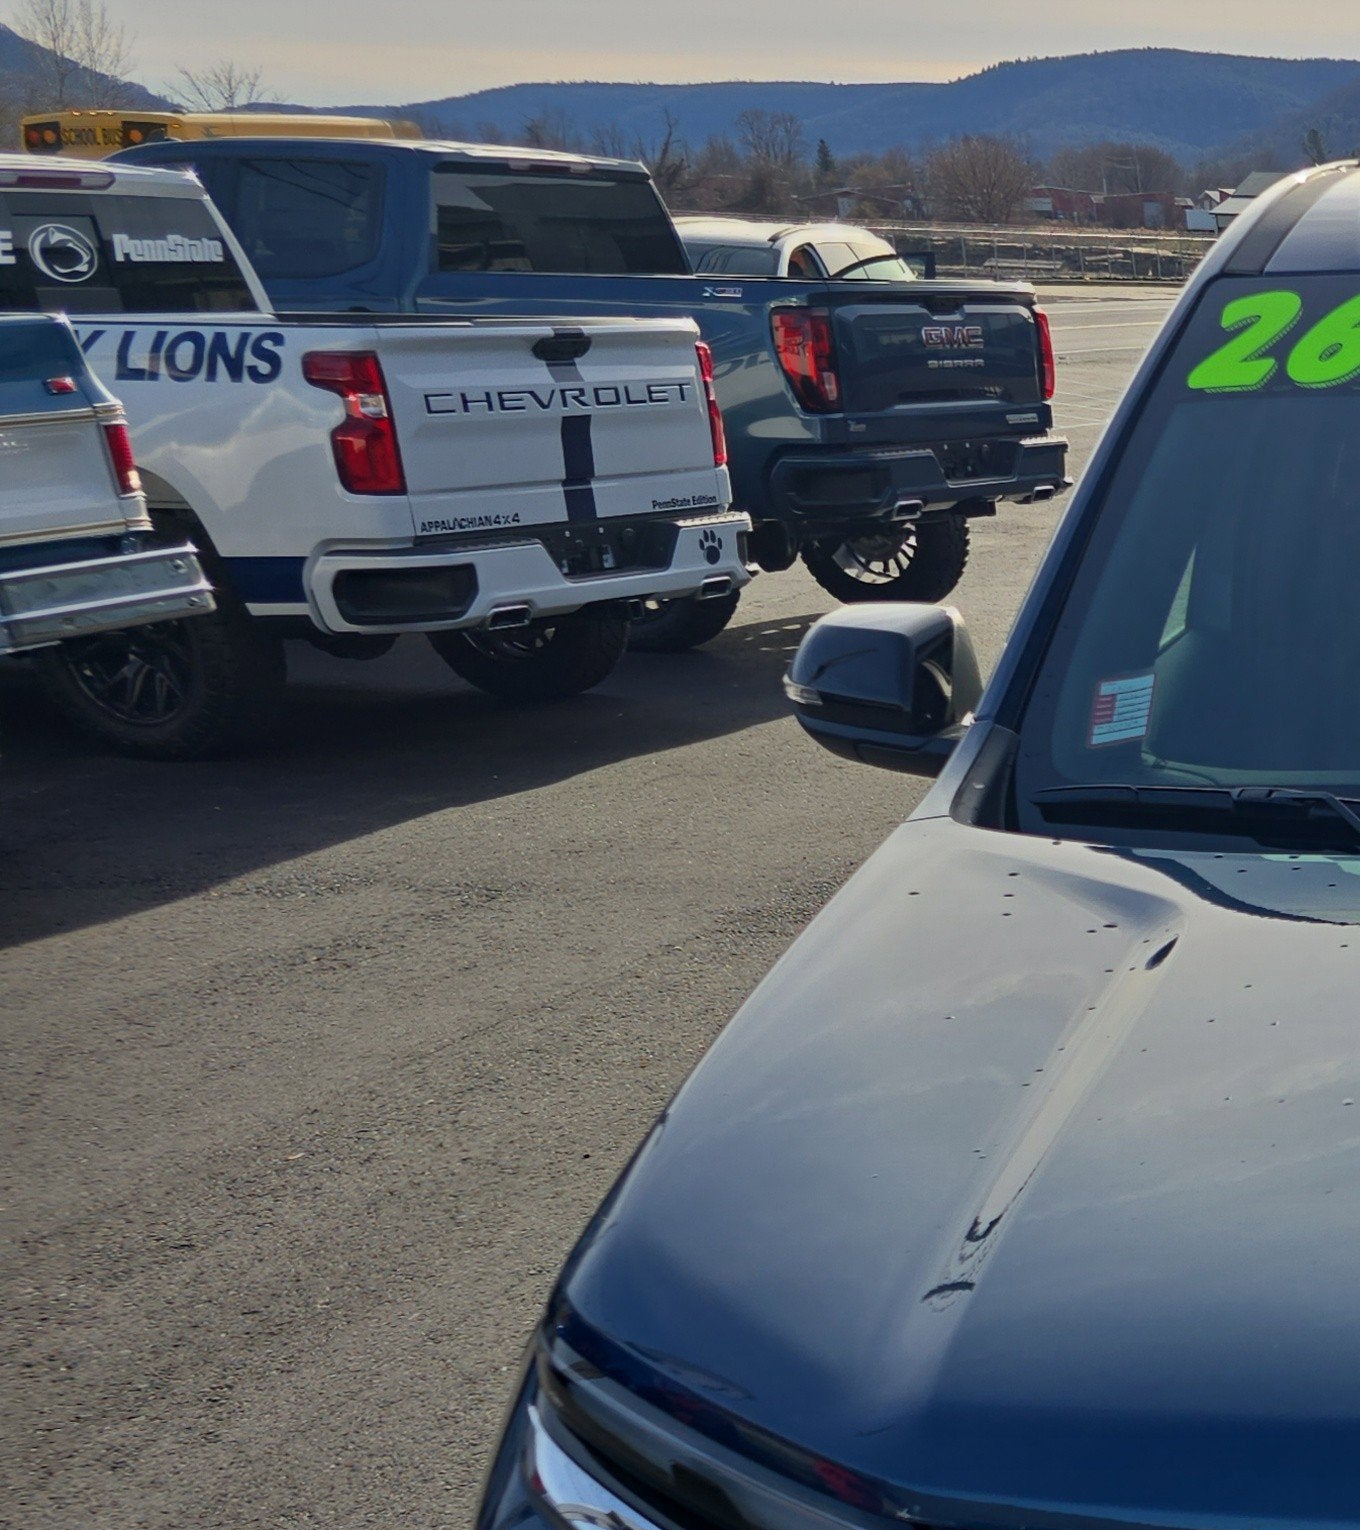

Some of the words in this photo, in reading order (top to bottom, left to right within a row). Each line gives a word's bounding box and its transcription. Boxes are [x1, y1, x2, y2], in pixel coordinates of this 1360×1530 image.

[112, 233, 224, 262] PennState
[921, 325, 985, 349] GMC
[115, 329, 286, 384] LIONS
[926, 359, 986, 369] SIERRA
[423, 383, 692, 415] CHEVROLET
